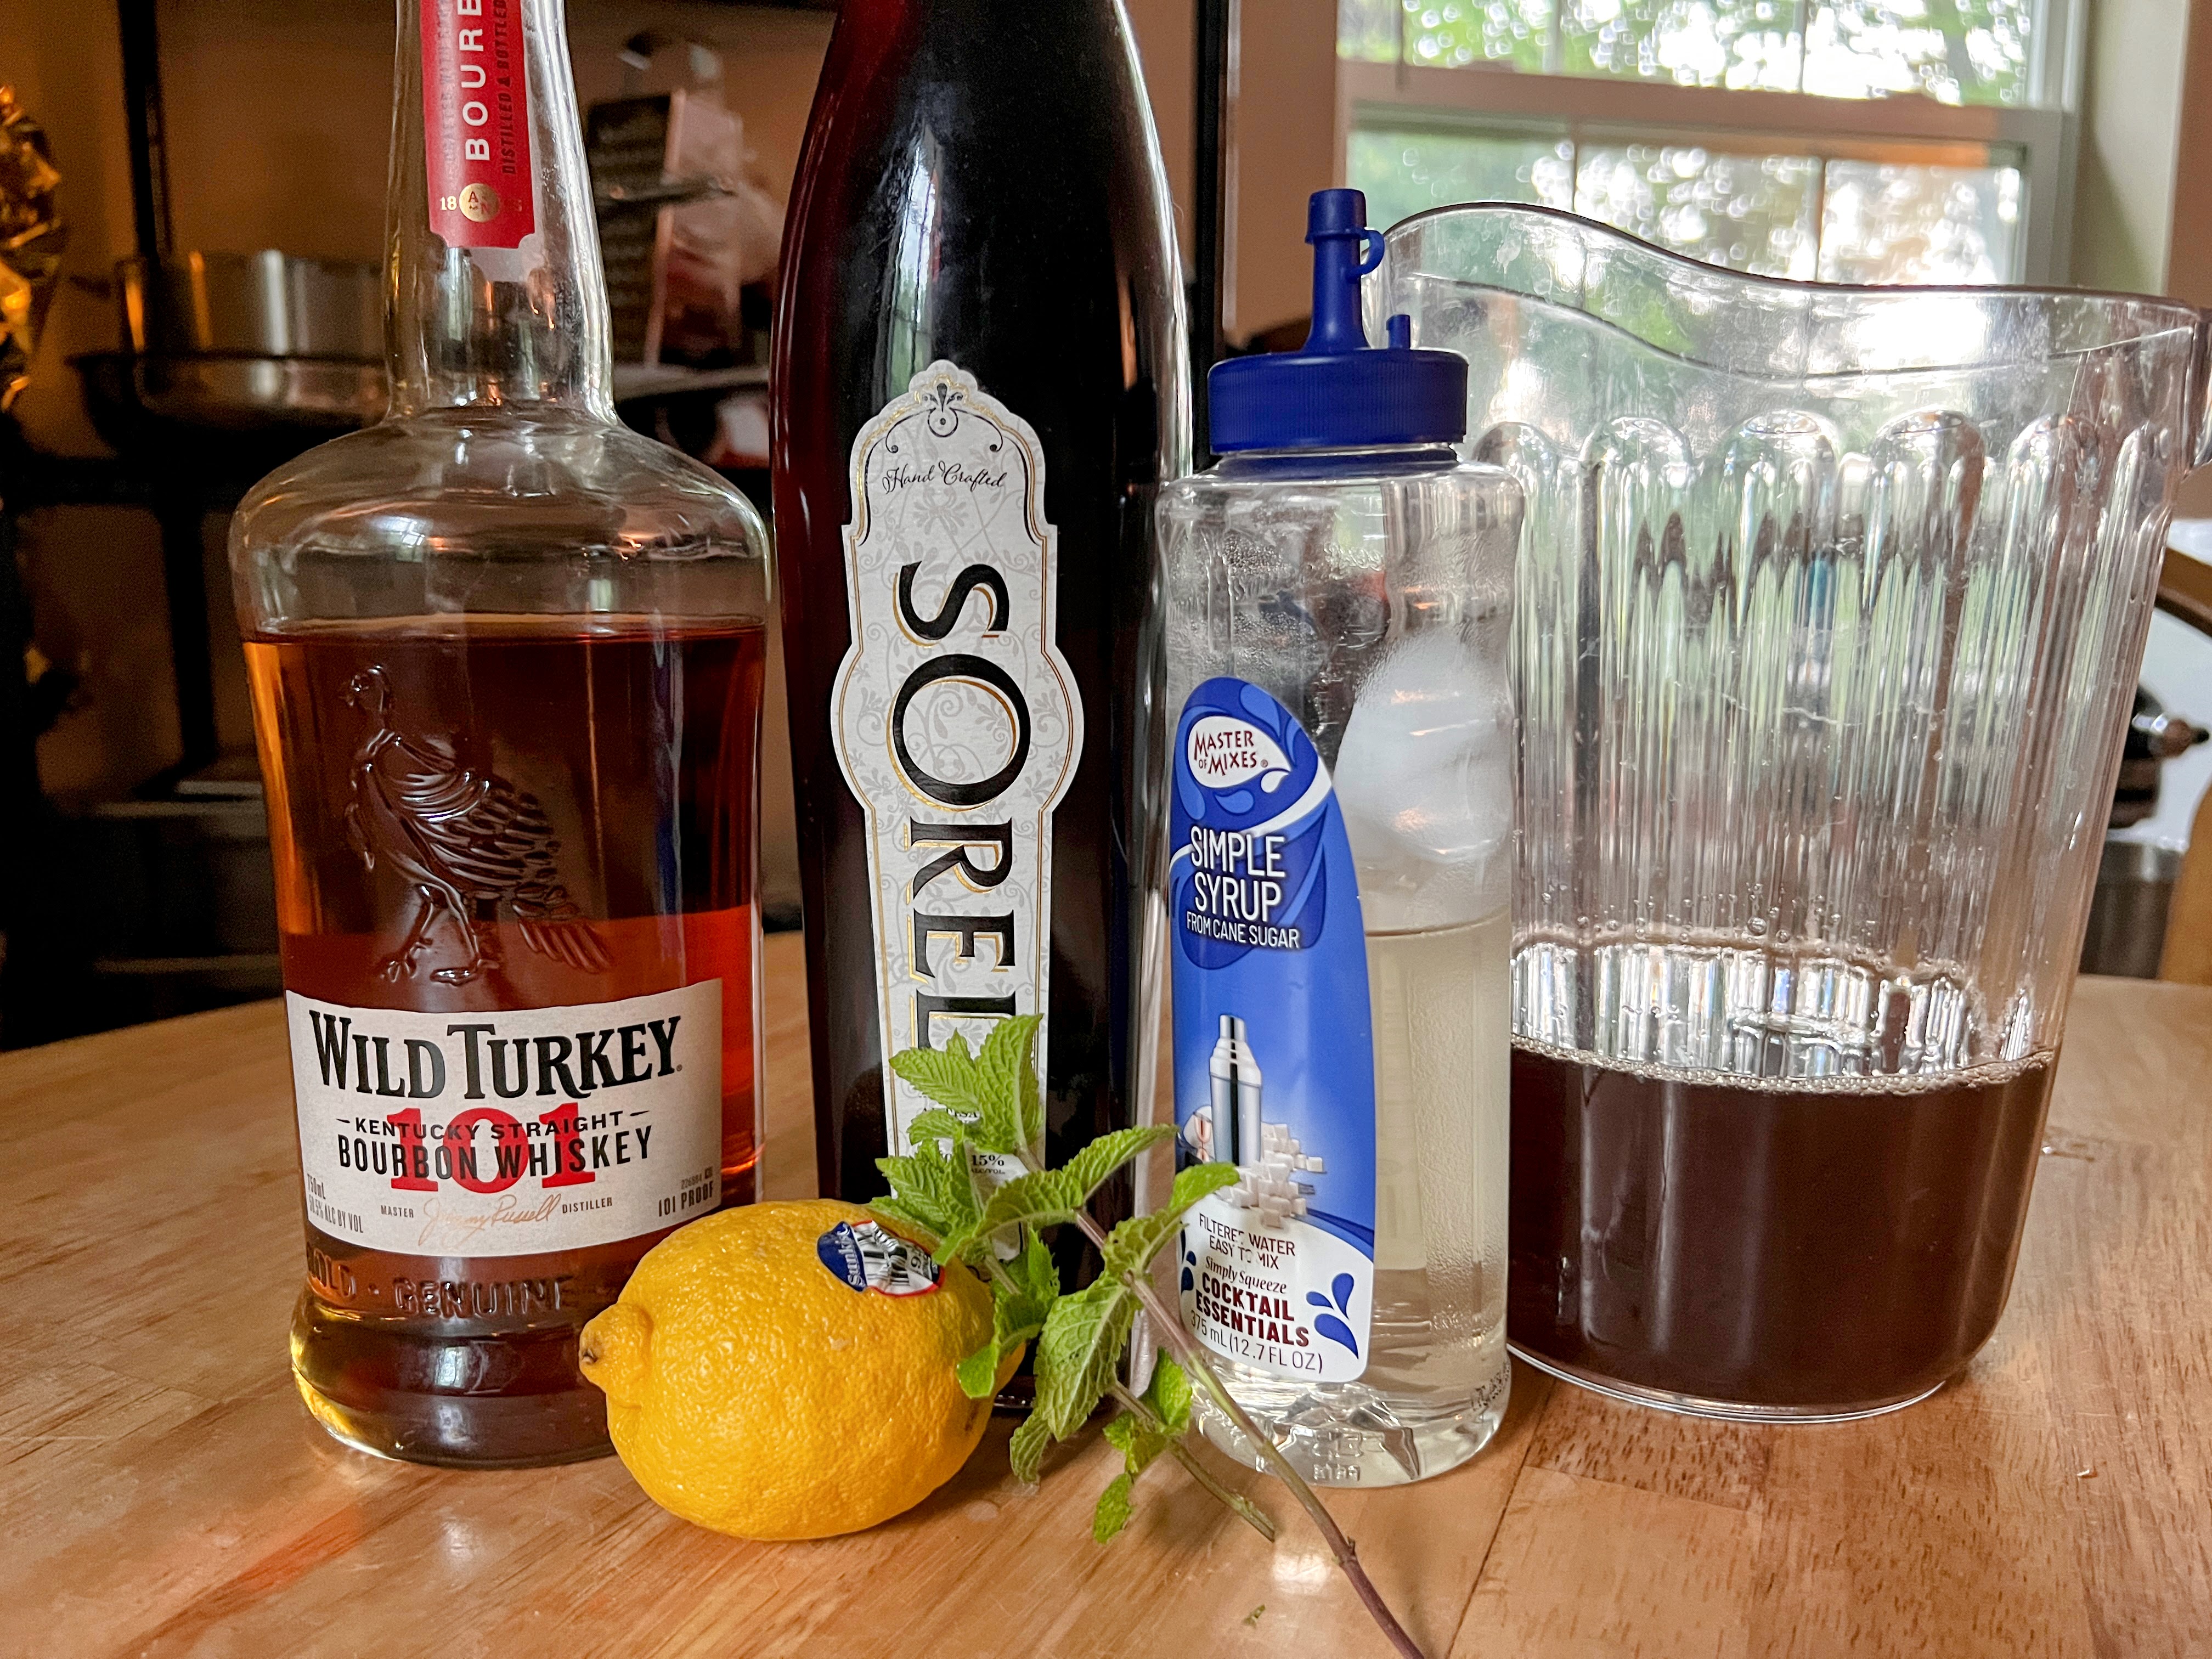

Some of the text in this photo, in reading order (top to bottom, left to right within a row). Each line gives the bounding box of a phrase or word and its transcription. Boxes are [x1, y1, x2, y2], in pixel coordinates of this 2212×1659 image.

[493, 0, 510, 70] BOTTLED
[496, 93, 516, 175] DISTILLED
[440, 196, 457, 211] 18
[883, 460, 1008, 495] Hand Crafted
[1193, 730, 1255, 761] MASTER
[1198, 751, 1257, 776] OF MIXES
[890, 560, 1032, 1049] SOREL
[1190, 826, 1285, 878] SIMPLE
[1195, 872, 1282, 922] SYRUP
[1187, 911, 1300, 949] FROM CANE SUGAR
[309, 1009, 682, 1100] WILD TURKEY
[355, 1110, 624, 1140] KENTUCKY STRAIGHT
[337, 1125, 652, 1180] BOURBON WHISKEY
[386, 1103, 596, 1194] 101
[972, 1154, 1005, 1166] 15%
[380, 1205, 414, 1218] MASTER
[562, 1197, 613, 1214] DISTILLER
[658, 1180, 713, 1217] 101 PROOF
[325, 1204, 336, 1224] ALC
[337, 1209, 346, 1229] BY
[348, 1212, 364, 1233] VOL
[1209, 1235, 1234, 1257] EASY
[1248, 1232, 1296, 1256] WATER
[1206, 1256, 1287, 1294] Simply Squeeze
[1202, 1272, 1295, 1322] COCKTAIL
[1196, 1289, 1310, 1347] ESSENTIALS
[1190, 1309, 1323, 1374] 375 mL (12.7 FL OZ)
